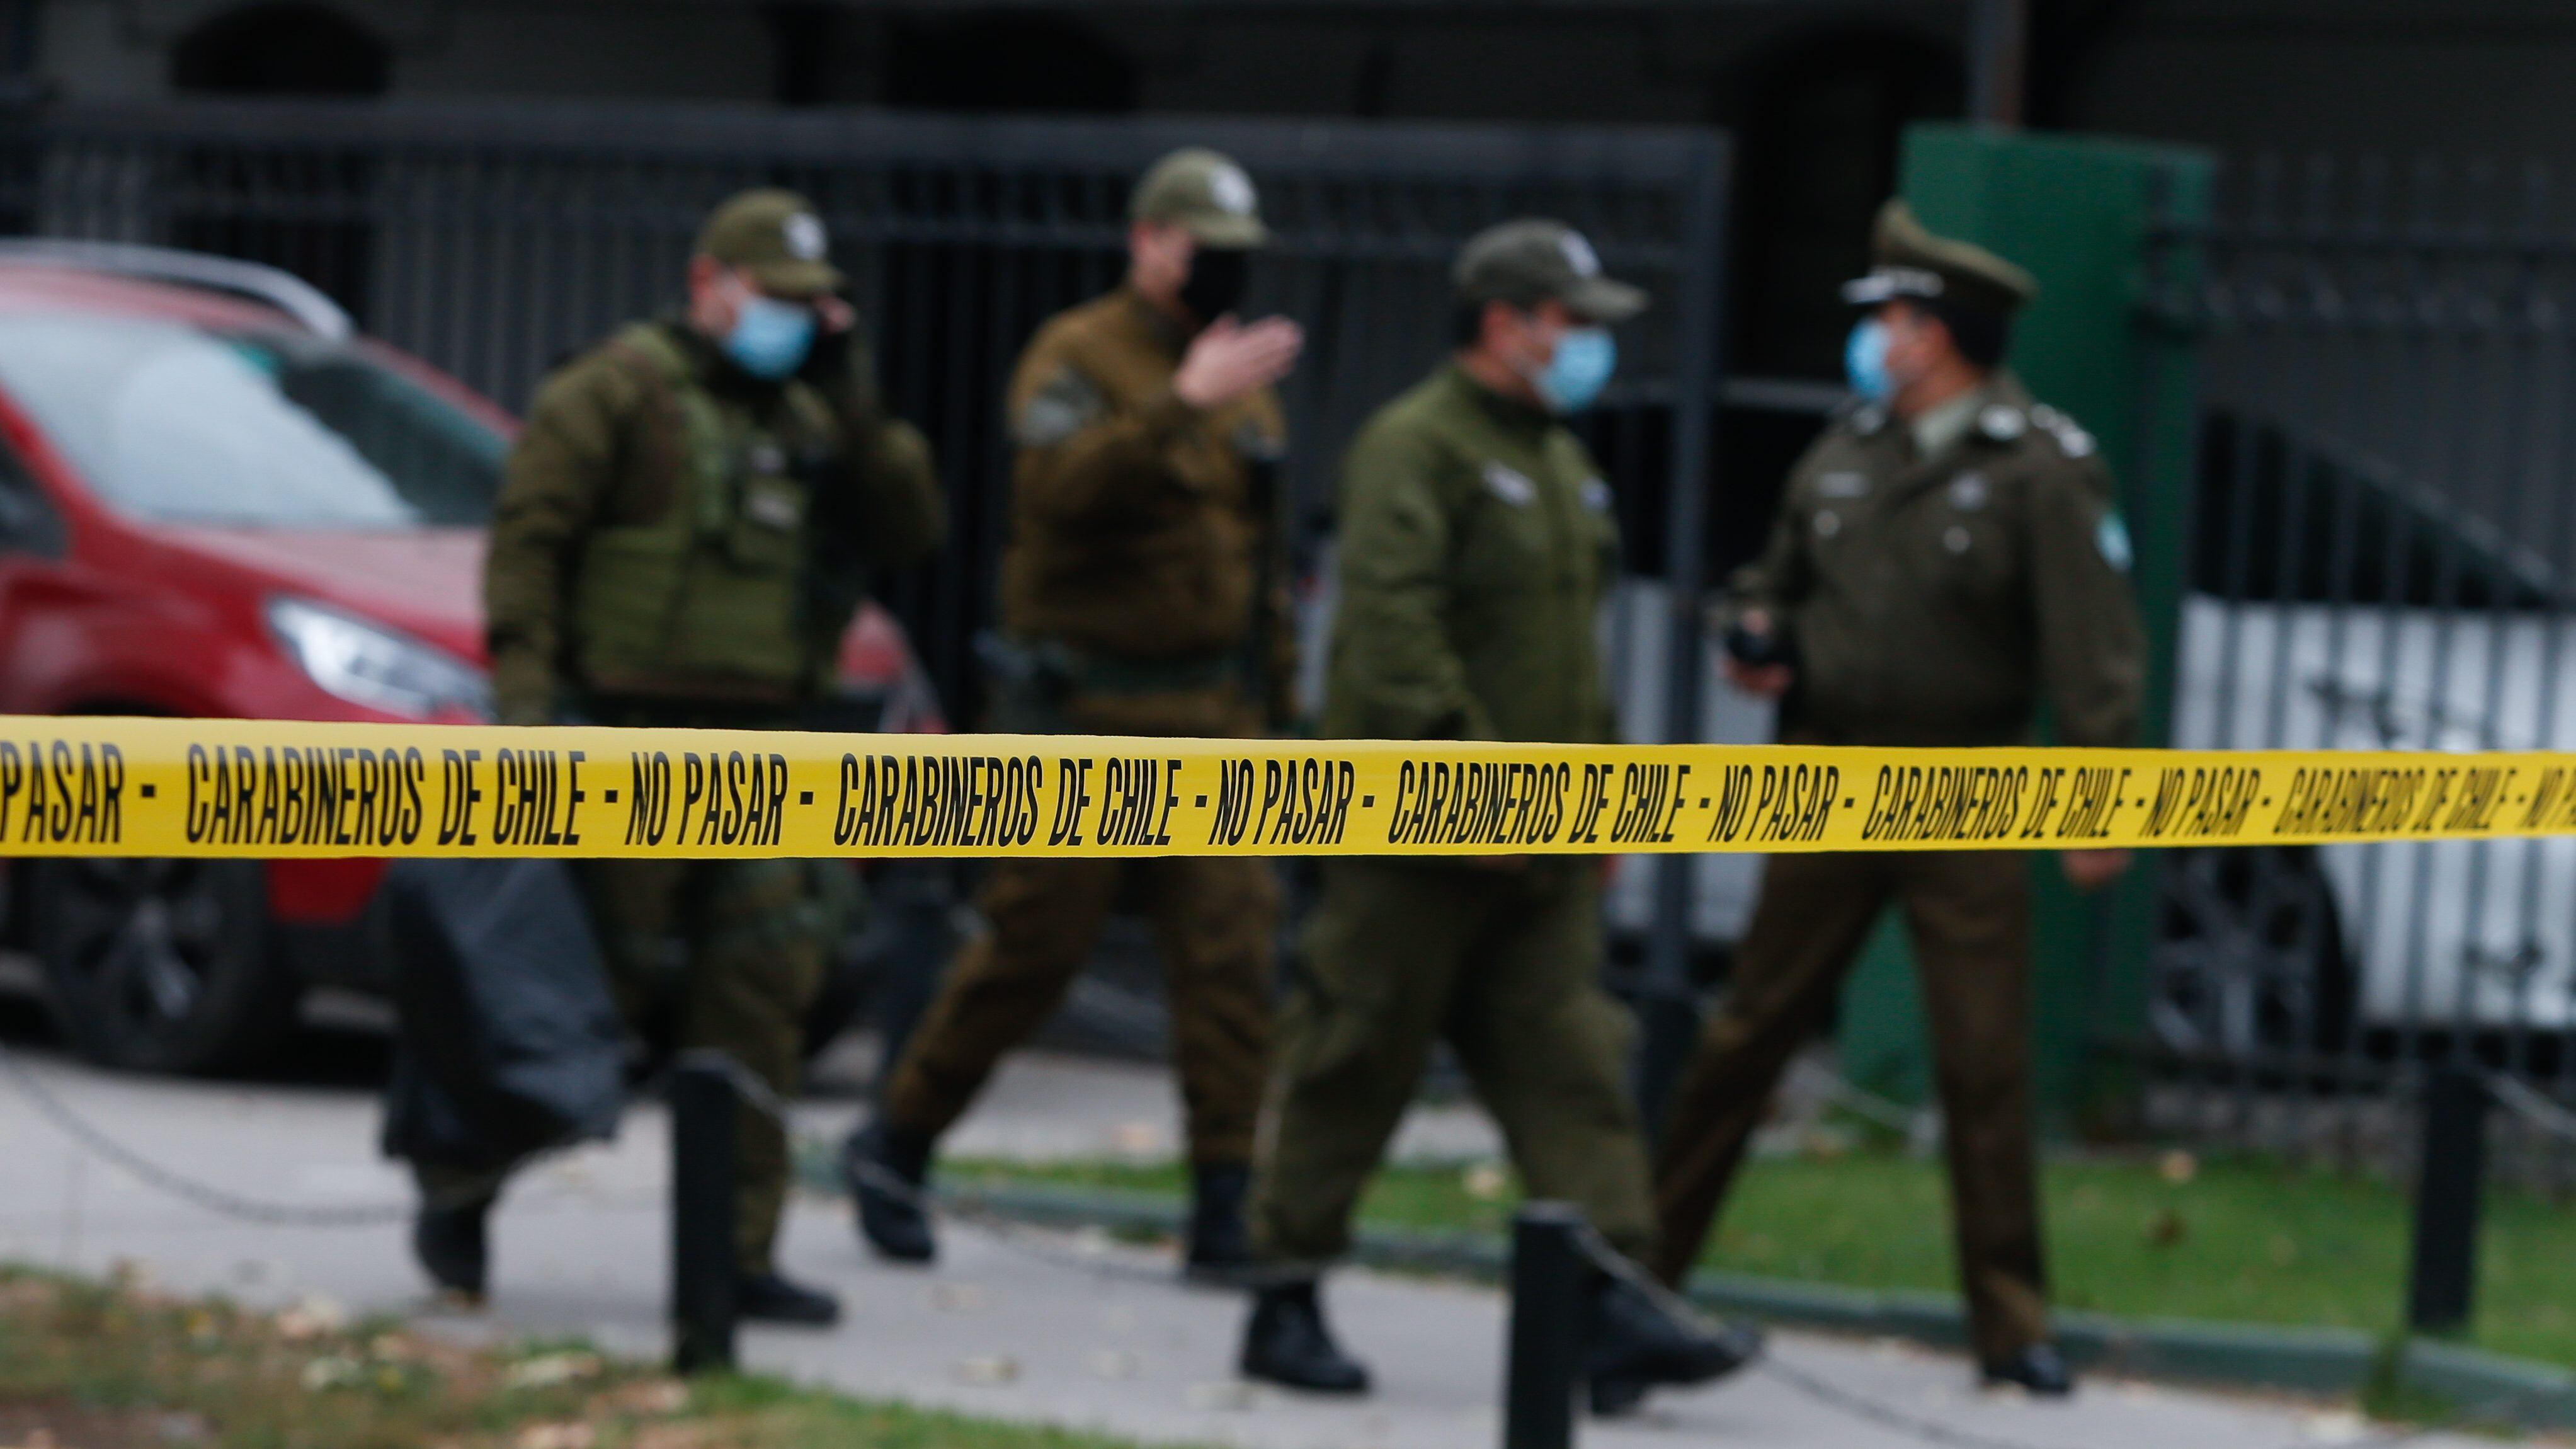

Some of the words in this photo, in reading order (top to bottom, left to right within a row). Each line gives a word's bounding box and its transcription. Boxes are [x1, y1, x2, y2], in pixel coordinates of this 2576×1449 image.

[0, 740, 125, 844] PASAR
[185, 743, 425, 847] CARABINEROS
[436, 750, 482, 847] DE
[492, 748, 586, 846] CHILE
[624, 750, 671, 847] NO
[676, 751, 789, 846] PASAR
[833, 753, 1043, 847] CARABINEROS
[1047, 758, 1091, 847] DE
[1096, 757, 1183, 846] CHILE
[1207, 759, 1255, 847] NO
[1251, 757, 1355, 845] PASAR
[1388, 760, 1571, 845] CARABINEROS
[1566, 763, 1615, 844] DE
[1610, 762, 1692, 844] CHILE
[1706, 764, 1753, 842] NO
[1745, 763, 1840, 842] PASAR
[1861, 764, 2029, 840] CARABINEROS
[2019, 767, 2066, 839] DE
[2055, 766, 2133, 839] CHILE
[2138, 767, 2186, 838] NO
[2171, 766, 2260, 837] PASAR
[2411, 768, 2459, 832] DE
[2442, 767, 2517, 830] CHILE
